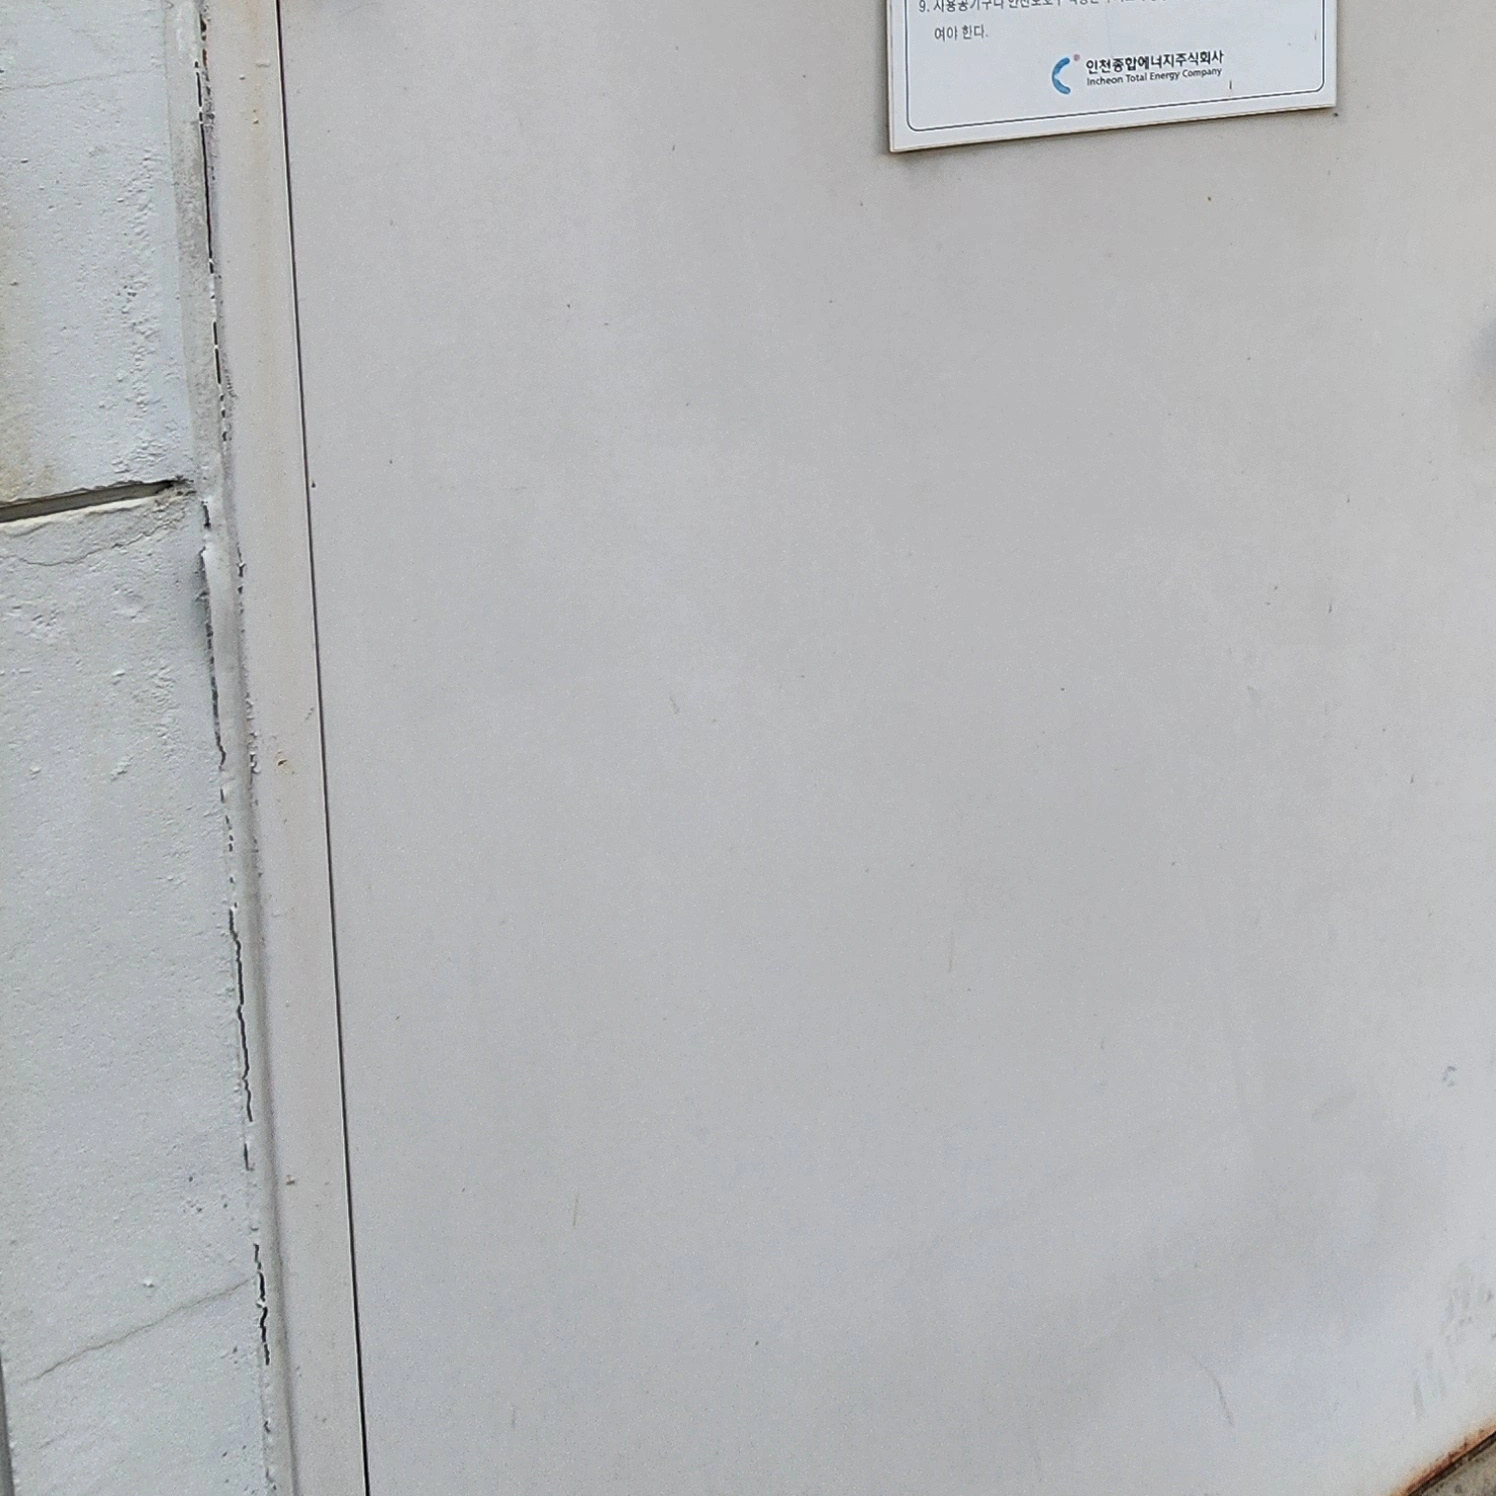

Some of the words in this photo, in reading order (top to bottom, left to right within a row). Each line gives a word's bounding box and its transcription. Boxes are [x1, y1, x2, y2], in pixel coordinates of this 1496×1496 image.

[919, 0, 930, 12] 9.
[934, 26, 957, 42] 여야
[1085, 50, 1224, 75] 인천종합에너지주식회사
[1087, 76, 1124, 86] Incheon
[1125, 72, 1147, 83] Total
[1150, 72, 1180, 81] Energy
[1182, 68, 1222, 78] Company
